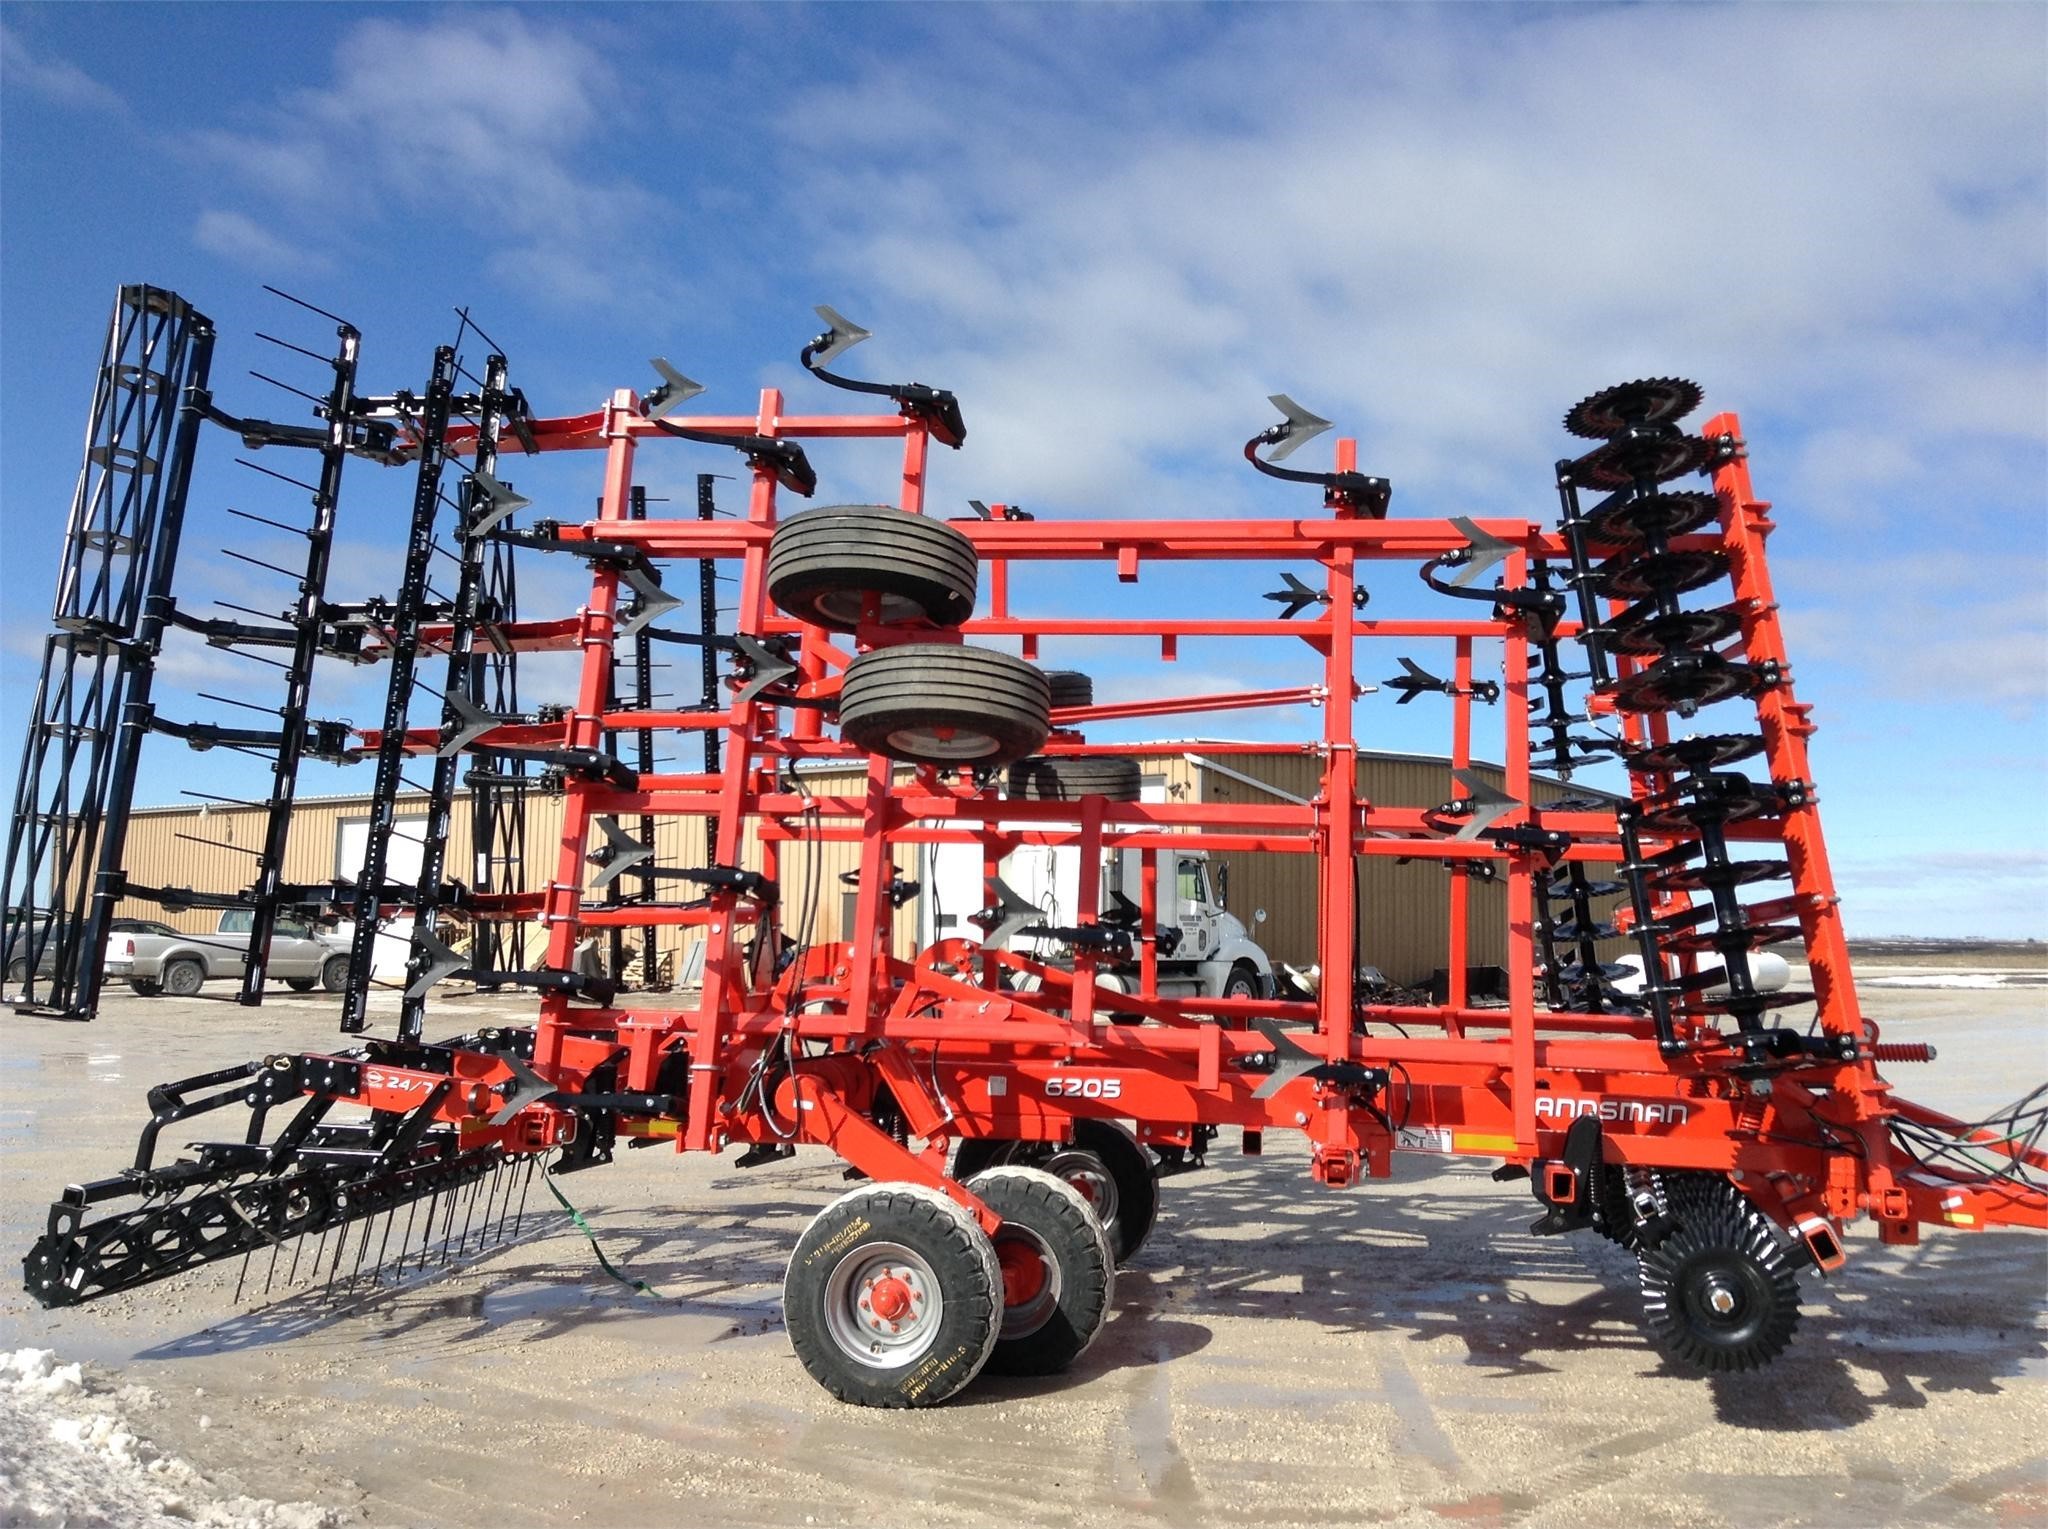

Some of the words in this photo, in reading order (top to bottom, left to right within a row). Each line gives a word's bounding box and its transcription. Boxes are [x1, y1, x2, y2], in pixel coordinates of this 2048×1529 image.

[387, 1076, 434, 1095] 24/7
[1044, 1078, 1121, 1098] 6205
[1535, 1096, 1688, 1126] ANDSMAN
